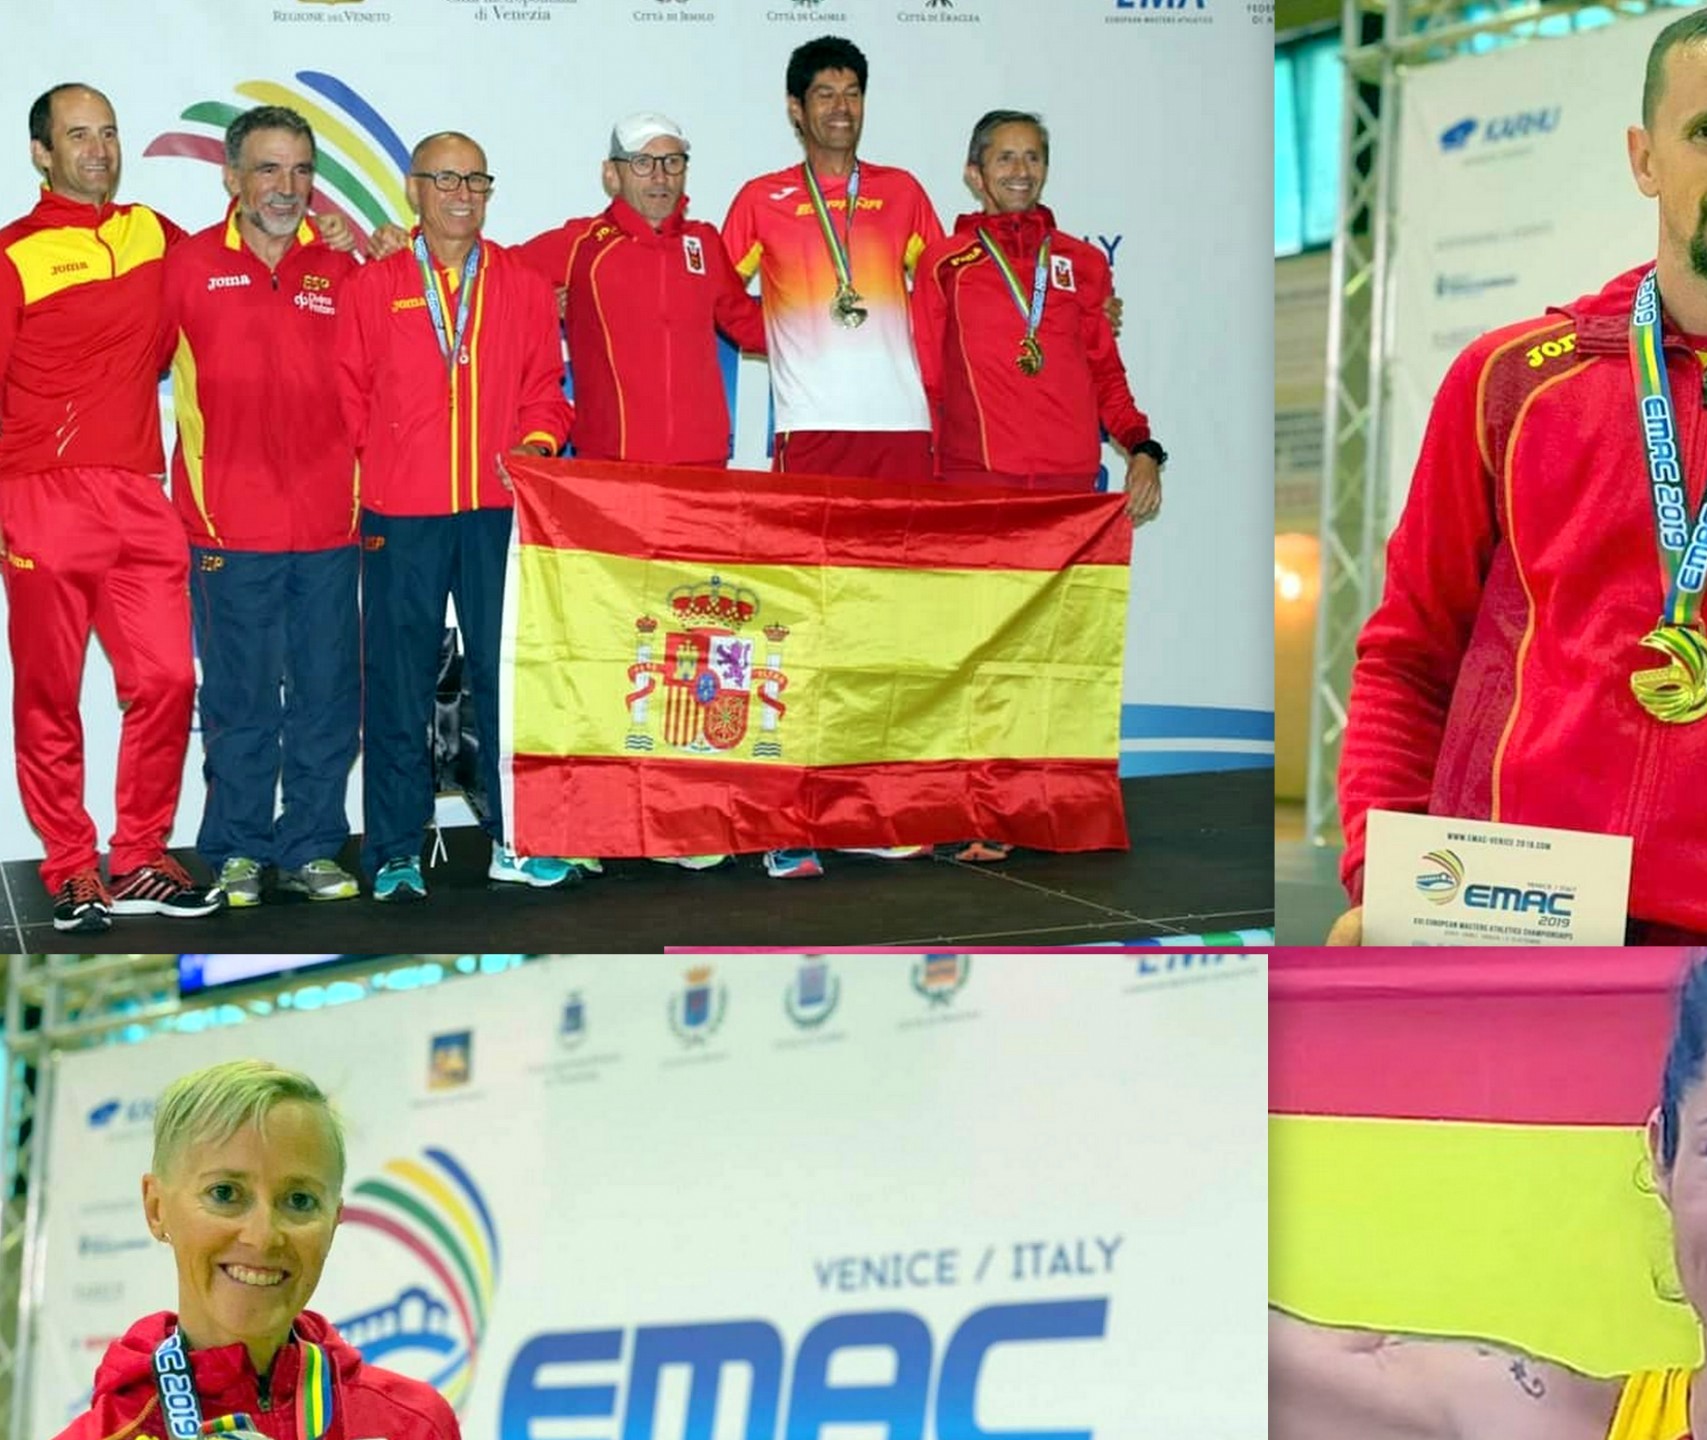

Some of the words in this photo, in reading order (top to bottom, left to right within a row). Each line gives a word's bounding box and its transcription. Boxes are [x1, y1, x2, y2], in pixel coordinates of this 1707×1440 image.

[1464, 884, 1575, 916] EMAC
[813, 1249, 960, 1292] VENICE
[1012, 1235, 1124, 1280] ITALY
[160, 1374, 199, 1439] 2019
